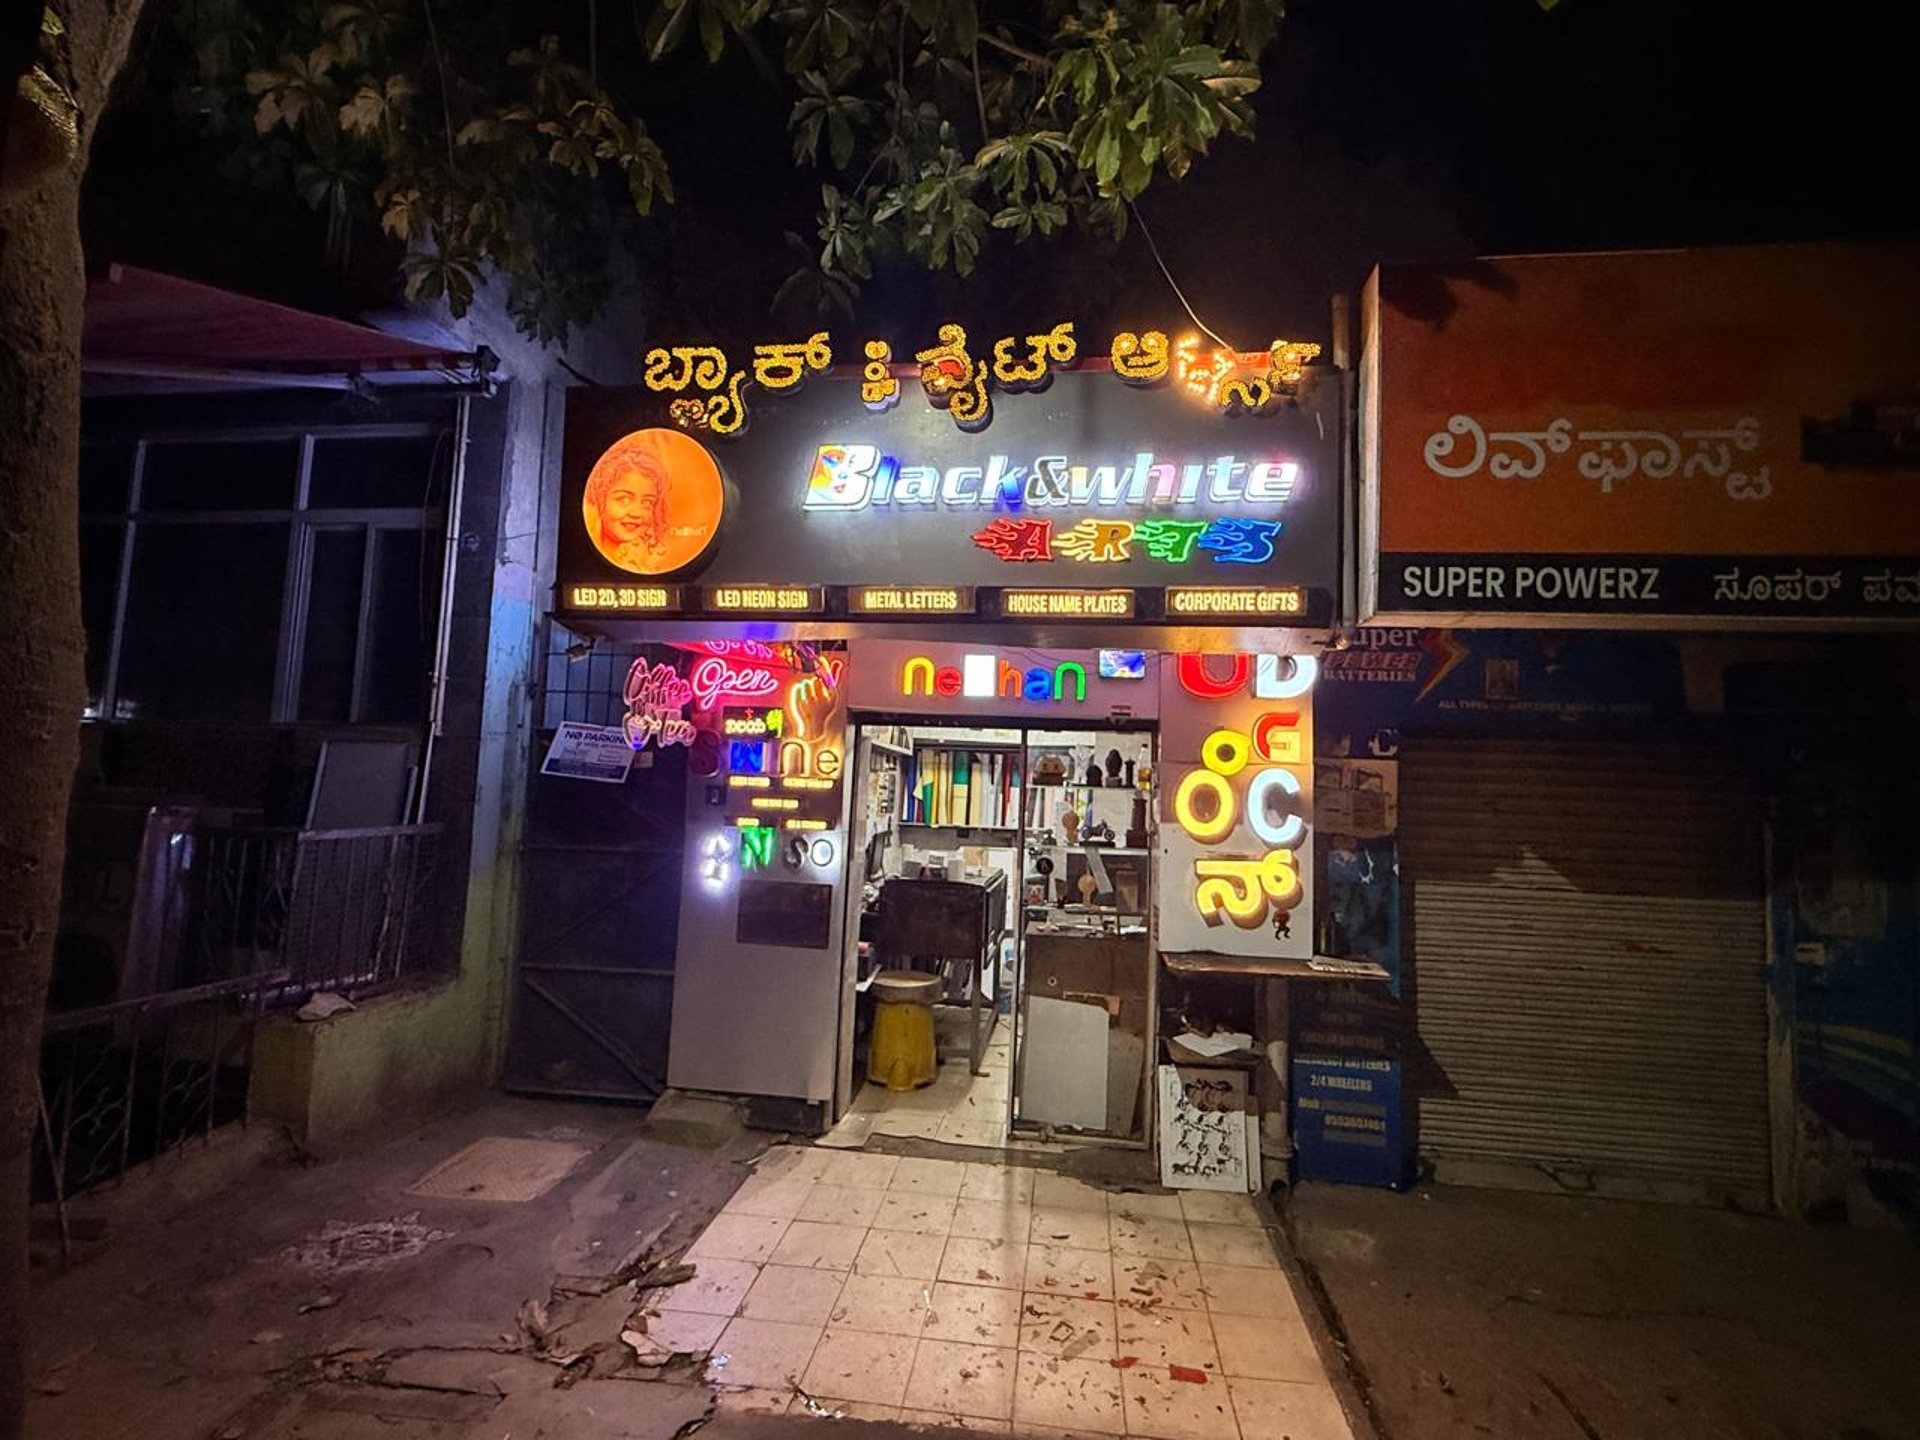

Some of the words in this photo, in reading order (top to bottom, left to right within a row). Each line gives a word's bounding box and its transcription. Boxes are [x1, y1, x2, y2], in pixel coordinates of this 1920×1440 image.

[972, 517, 1282, 563] ARTS
[1403, 566, 1505, 600] SUPER
[1515, 567, 1660, 601] POWERZ
[574, 588, 598, 606] LED
[599, 588, 618, 609] 2D,
[619, 589, 635, 607] 3D
[637, 589, 667, 608] SIGN
[717, 590, 741, 608] LED
[743, 590, 775, 609] NEON
[776, 591, 808, 610] SIGN
[865, 591, 904, 610] METAL
[906, 592, 957, 610] LETTERS
[1007, 594, 1047, 613] HOUSE
[1048, 595, 1083, 613] NAME
[1084, 595, 1128, 614] PLATES
[1174, 592, 1255, 612] CORPORATE
[1256, 593, 1299, 612] GIFTS
[1352, 628, 1418, 650] uper
[693, 657, 778, 710] Open
[583, 732, 628, 745] PARKIN
